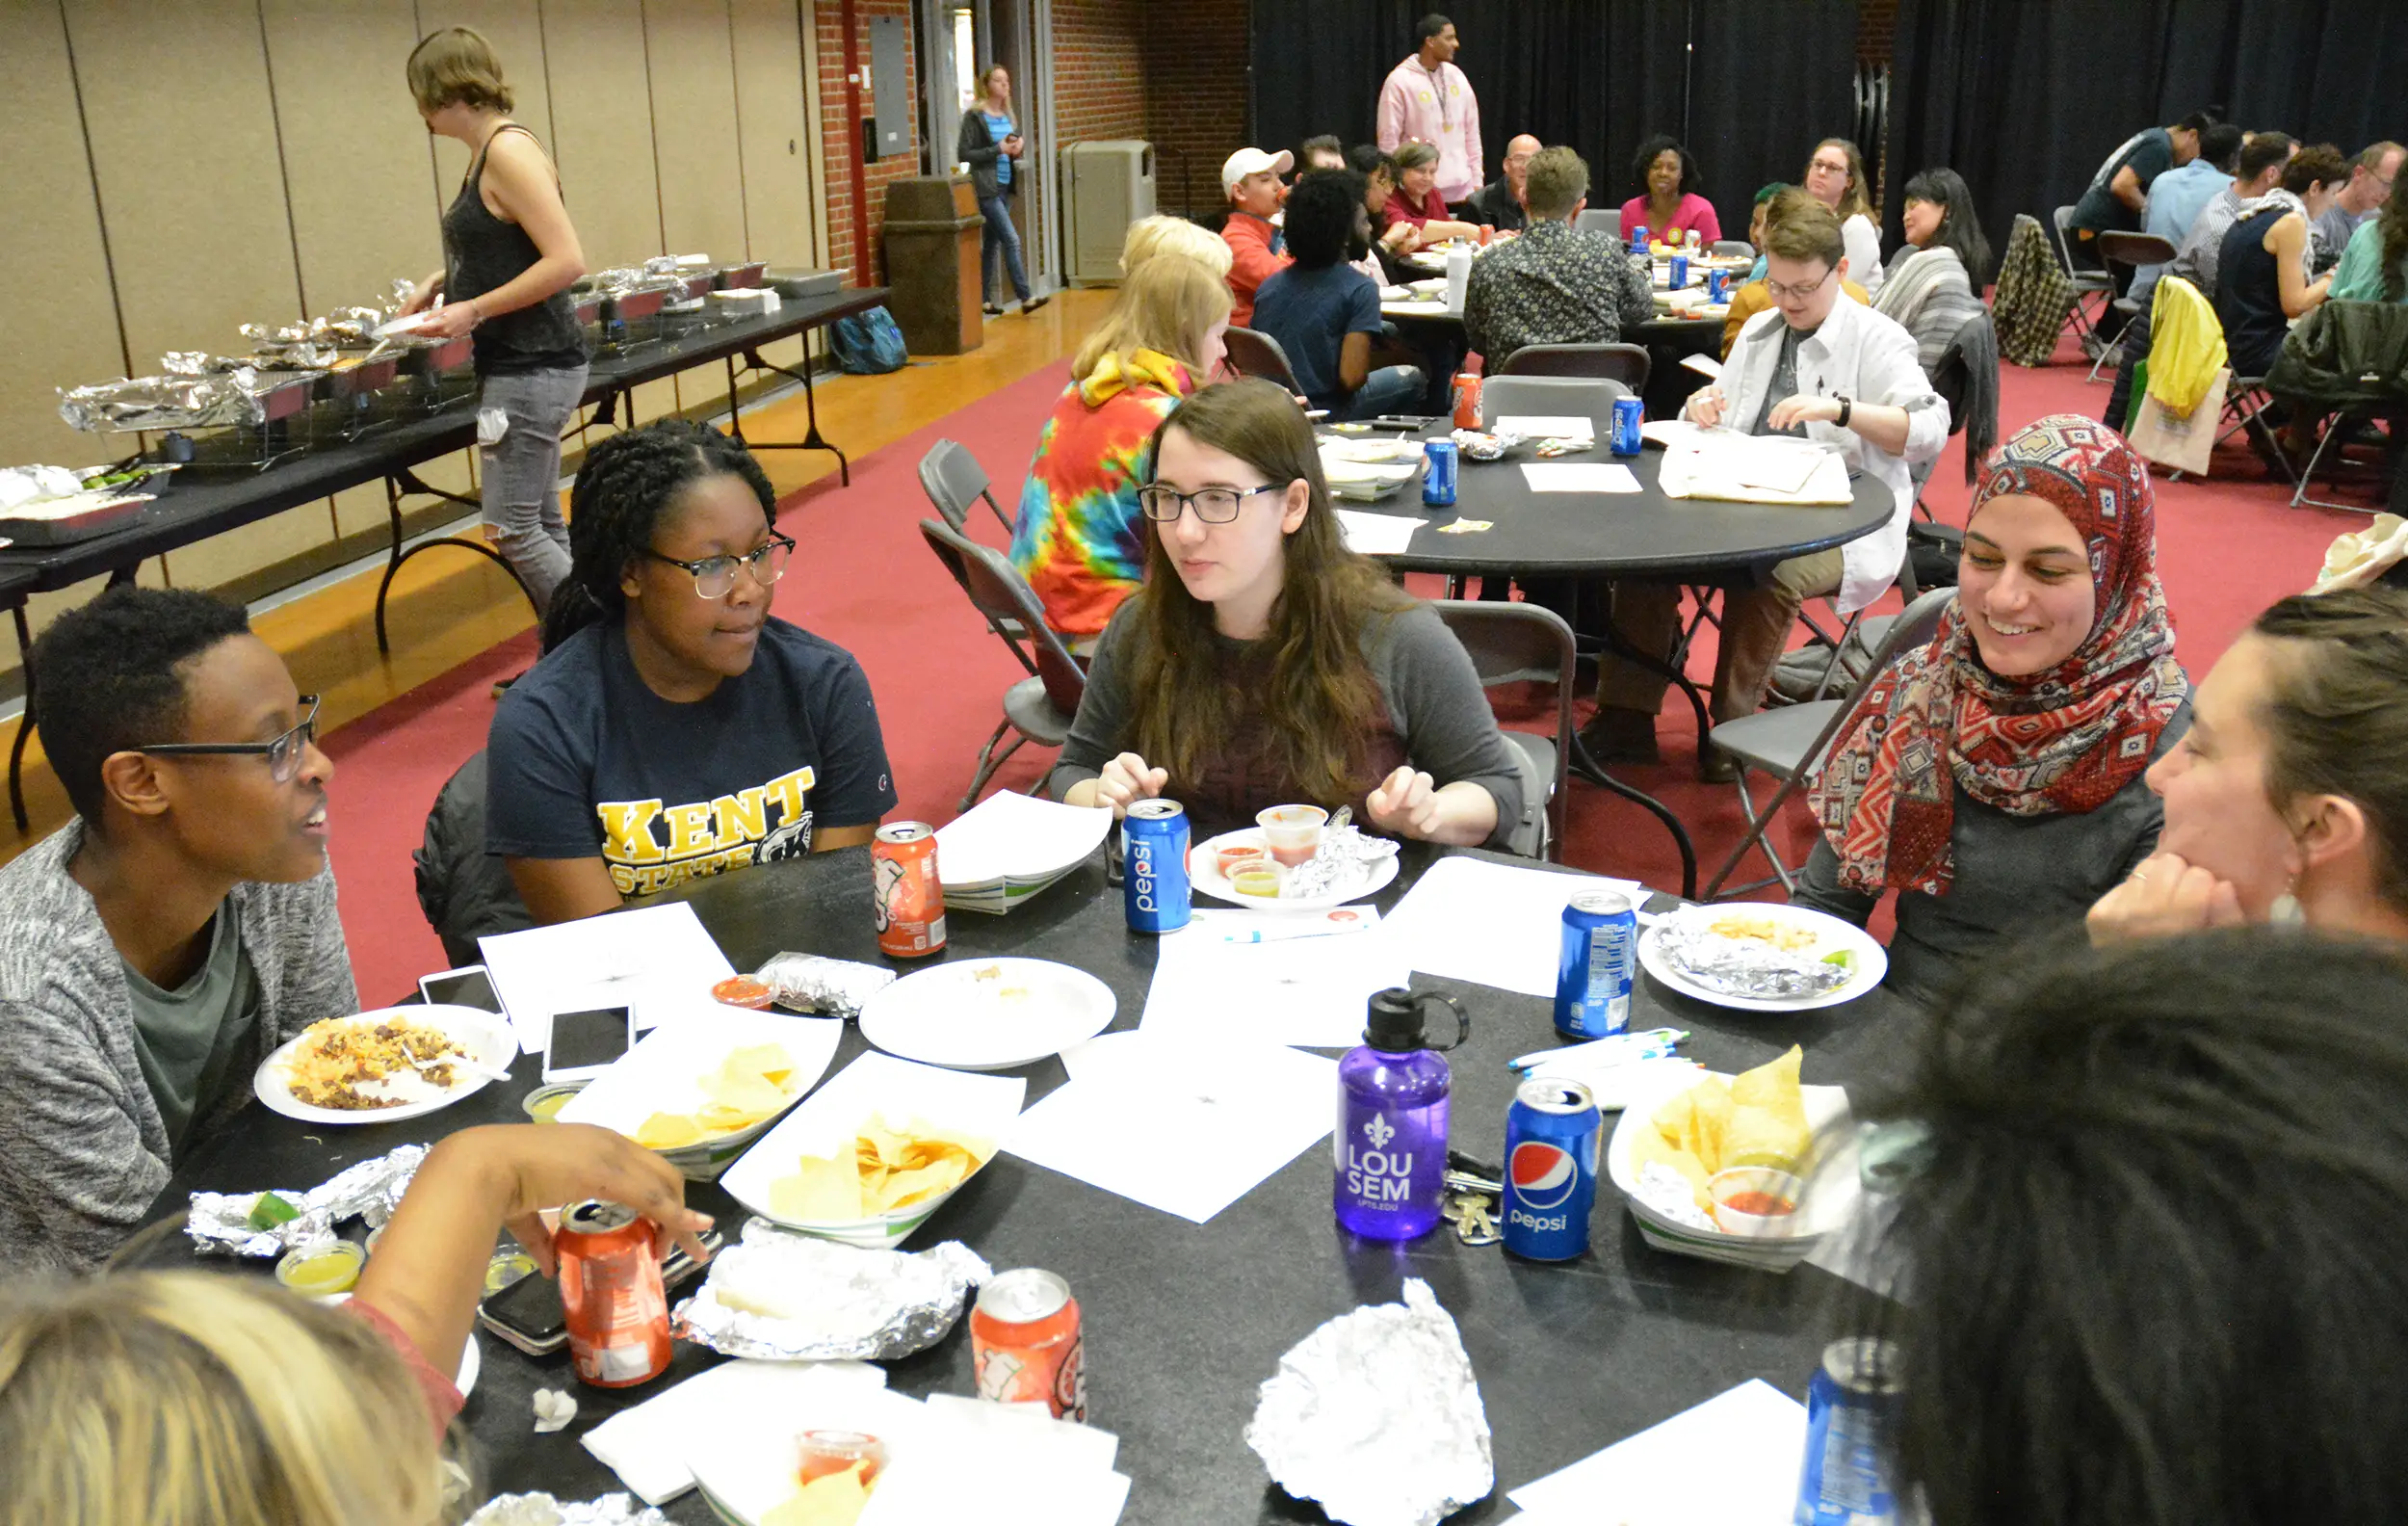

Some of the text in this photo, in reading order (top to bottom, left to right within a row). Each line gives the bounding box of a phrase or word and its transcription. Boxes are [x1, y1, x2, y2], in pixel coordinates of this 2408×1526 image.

[597, 766, 816, 864] KENT
[1131, 839, 1159, 912] pepsi
[1348, 1144, 1413, 1177] LOU
[1348, 1170, 1410, 1201] SEM
[1510, 1209, 1567, 1233] pepsi
